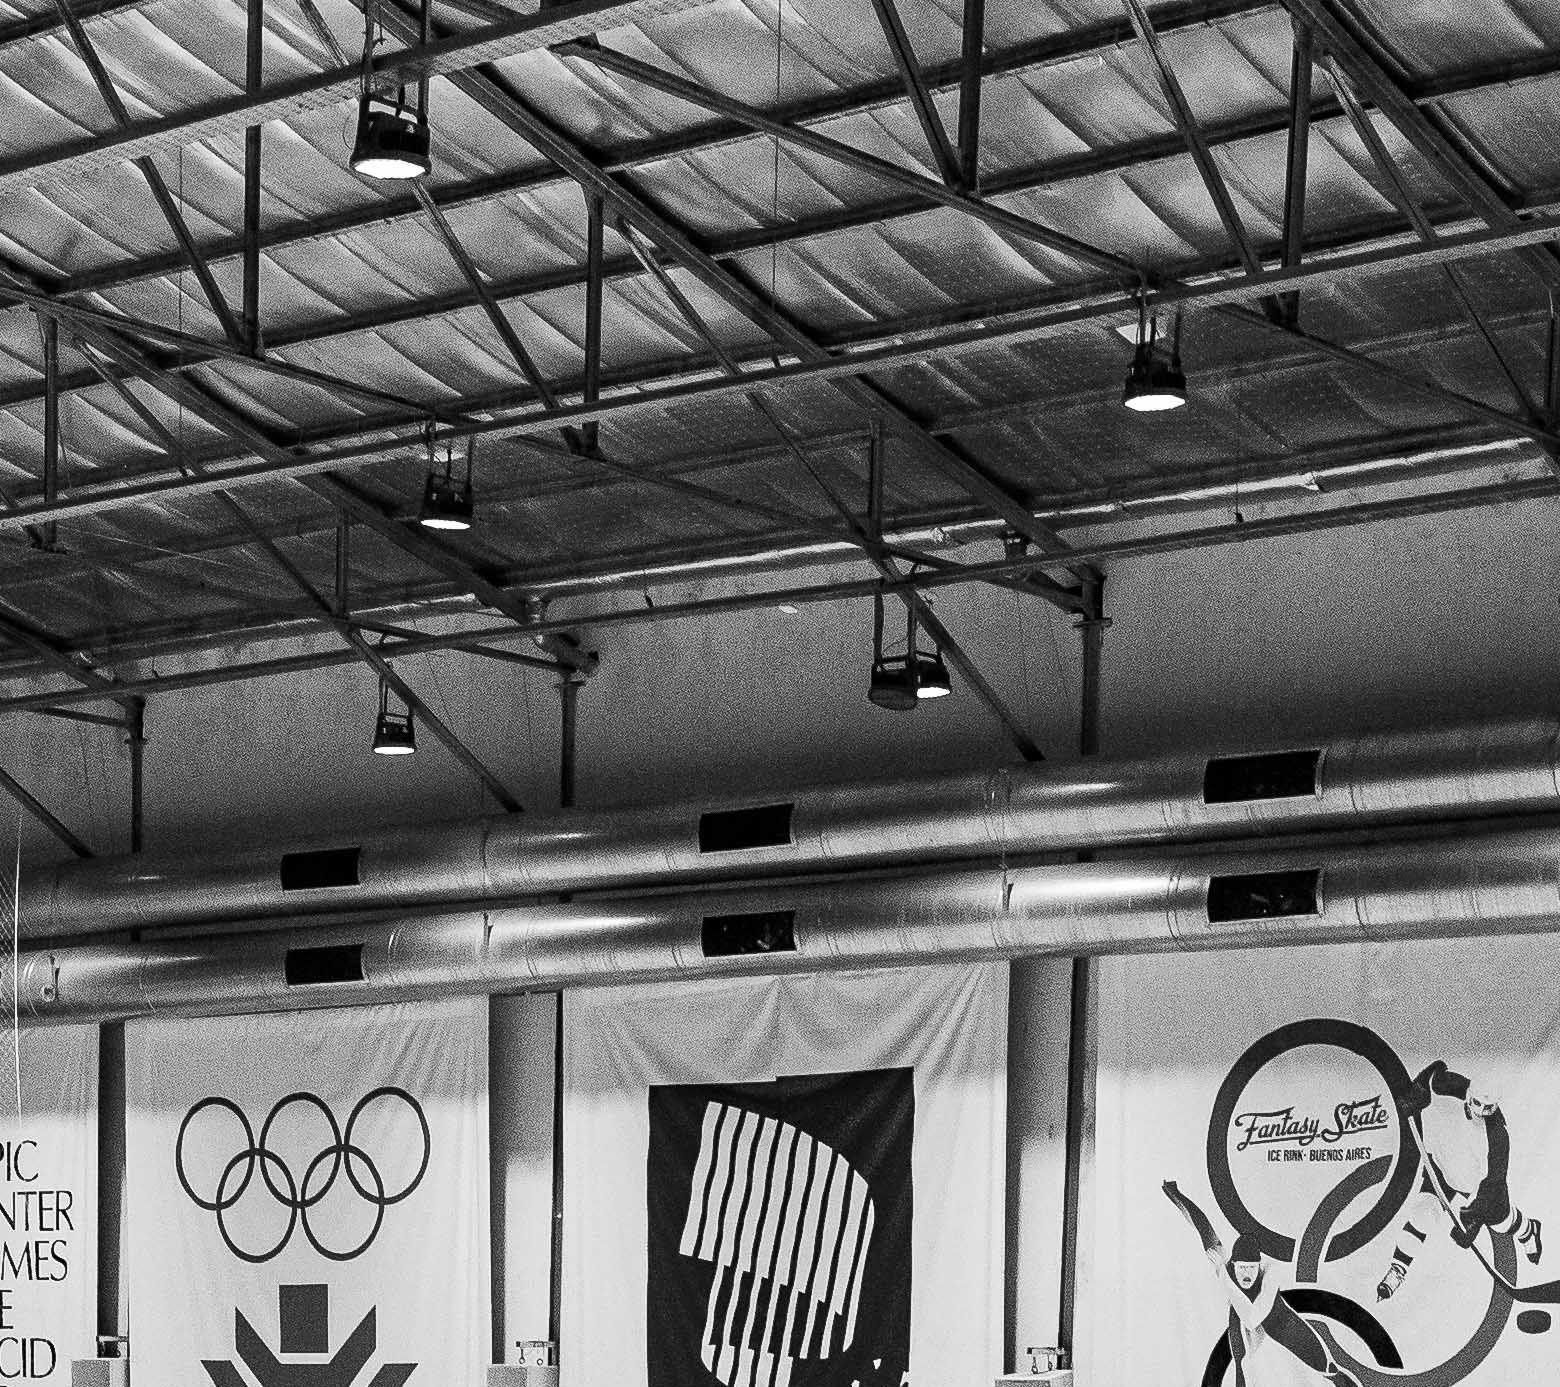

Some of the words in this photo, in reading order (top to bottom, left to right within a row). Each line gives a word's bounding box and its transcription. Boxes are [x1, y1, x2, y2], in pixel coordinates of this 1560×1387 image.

[1234, 1106, 1320, 1151] Fantasy
[1321, 1094, 1390, 1143] Skate
[1267, 1149, 1281, 1162] ICE
[1309, 1149, 1343, 1162] BUENOS
[1345, 1147, 1372, 1161] AIRES
